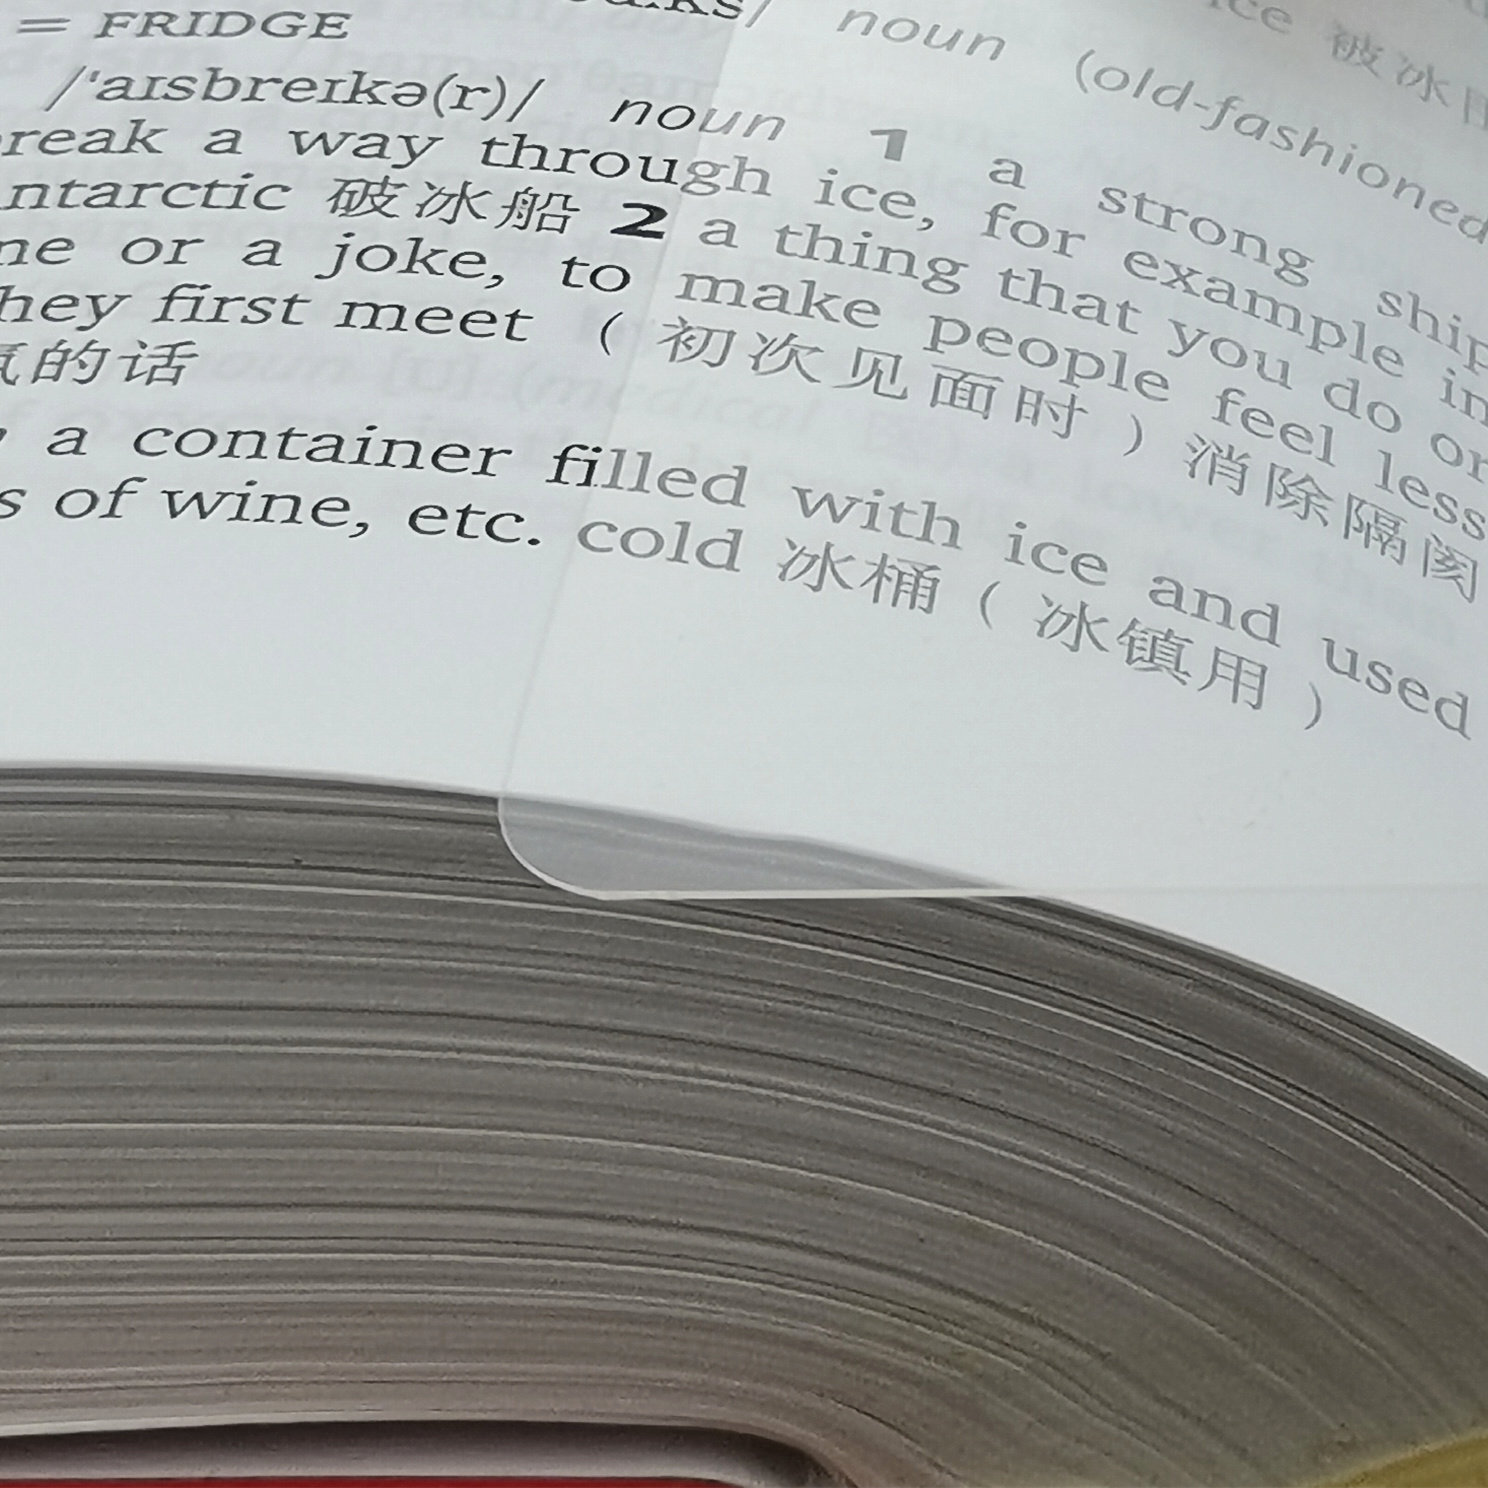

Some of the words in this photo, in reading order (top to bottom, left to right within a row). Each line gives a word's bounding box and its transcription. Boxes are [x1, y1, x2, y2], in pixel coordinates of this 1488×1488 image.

[94, 11, 353, 40] FRIDGE
[836, 5, 1007, 62] noun
[203, 127, 243, 156] a
[288, 128, 445, 170] way
[480, 134, 772, 197] through
[814, 168, 934, 232] ice,
[980, 202, 1086, 259] for
[1123, 248, 1405, 378] example
[610, 99, 786, 141] noun
[870, 128, 908, 162] 1
[988, 157, 1026, 189] a
[1098, 185, 1315, 287] strong
[120, 235, 204, 266] or
[241, 238, 282, 267] a
[315, 231, 505, 290] joke,
[561, 256, 632, 293] to
[674, 272, 881, 330] make
[922, 314, 1171, 403] people
[1211, 388, 1336, 468] feel
[1374, 451, 1488, 541] less
[151, 283, 312, 326] first
[333, 296, 534, 343] meet
[609, 202, 669, 240] 2
[698, 217, 739, 248] a
[774, 223, 970, 295] thing
[997, 268, 1144, 336] that
[1167, 318, 1293, 391] you
[1322, 378, 1404, 436] do
[46, 426, 87, 457] a
[132, 424, 513, 478] container
[544, 443, 750, 509] filled
[790, 483, 964, 551] with
[1002, 520, 1110, 588] ice
[1148, 574, 1283, 649] and
[1322, 634, 1472, 741] used
[54, 476, 148, 520] of
[161, 479, 372, 540] wine,
[406, 502, 541, 546] etc.
[576, 518, 744, 573] cold
